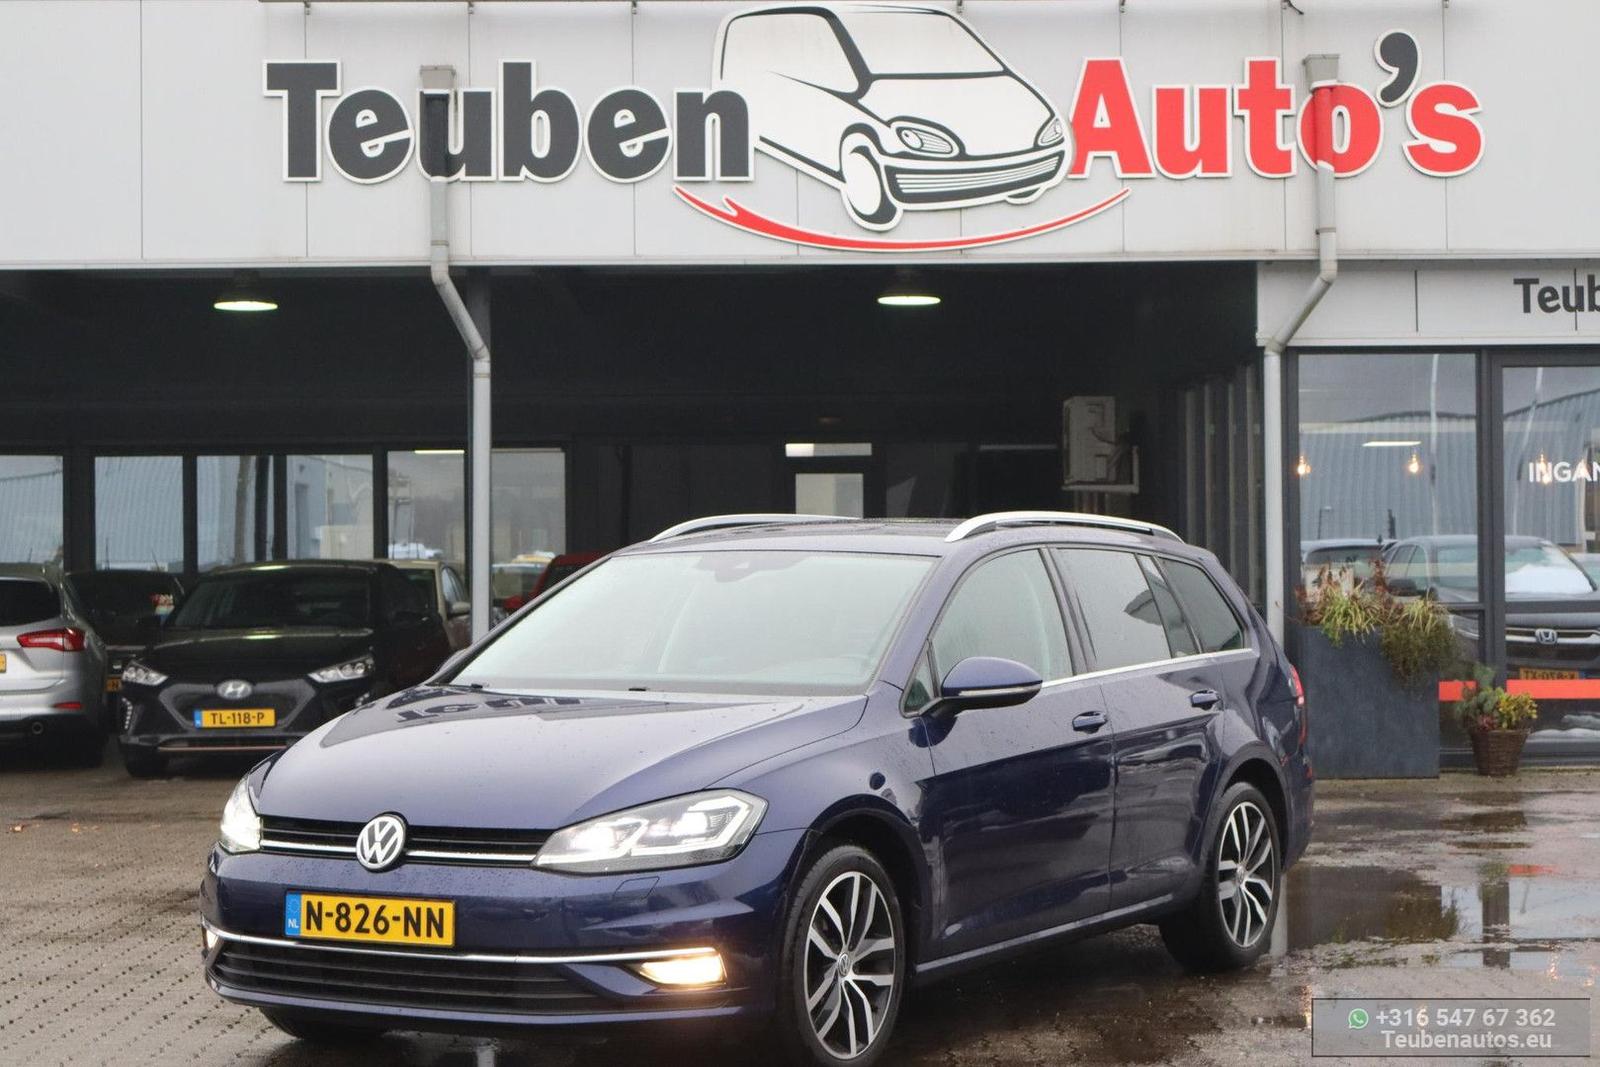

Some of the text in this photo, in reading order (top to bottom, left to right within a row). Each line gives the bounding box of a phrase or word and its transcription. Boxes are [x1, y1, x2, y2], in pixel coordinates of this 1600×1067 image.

[264, 30, 1484, 182] Teuben Auto's
[210, 712, 265, 725] TL-118-P
[288, 919, 299, 929] NL
[305, 900, 445, 939] N-826-NN
